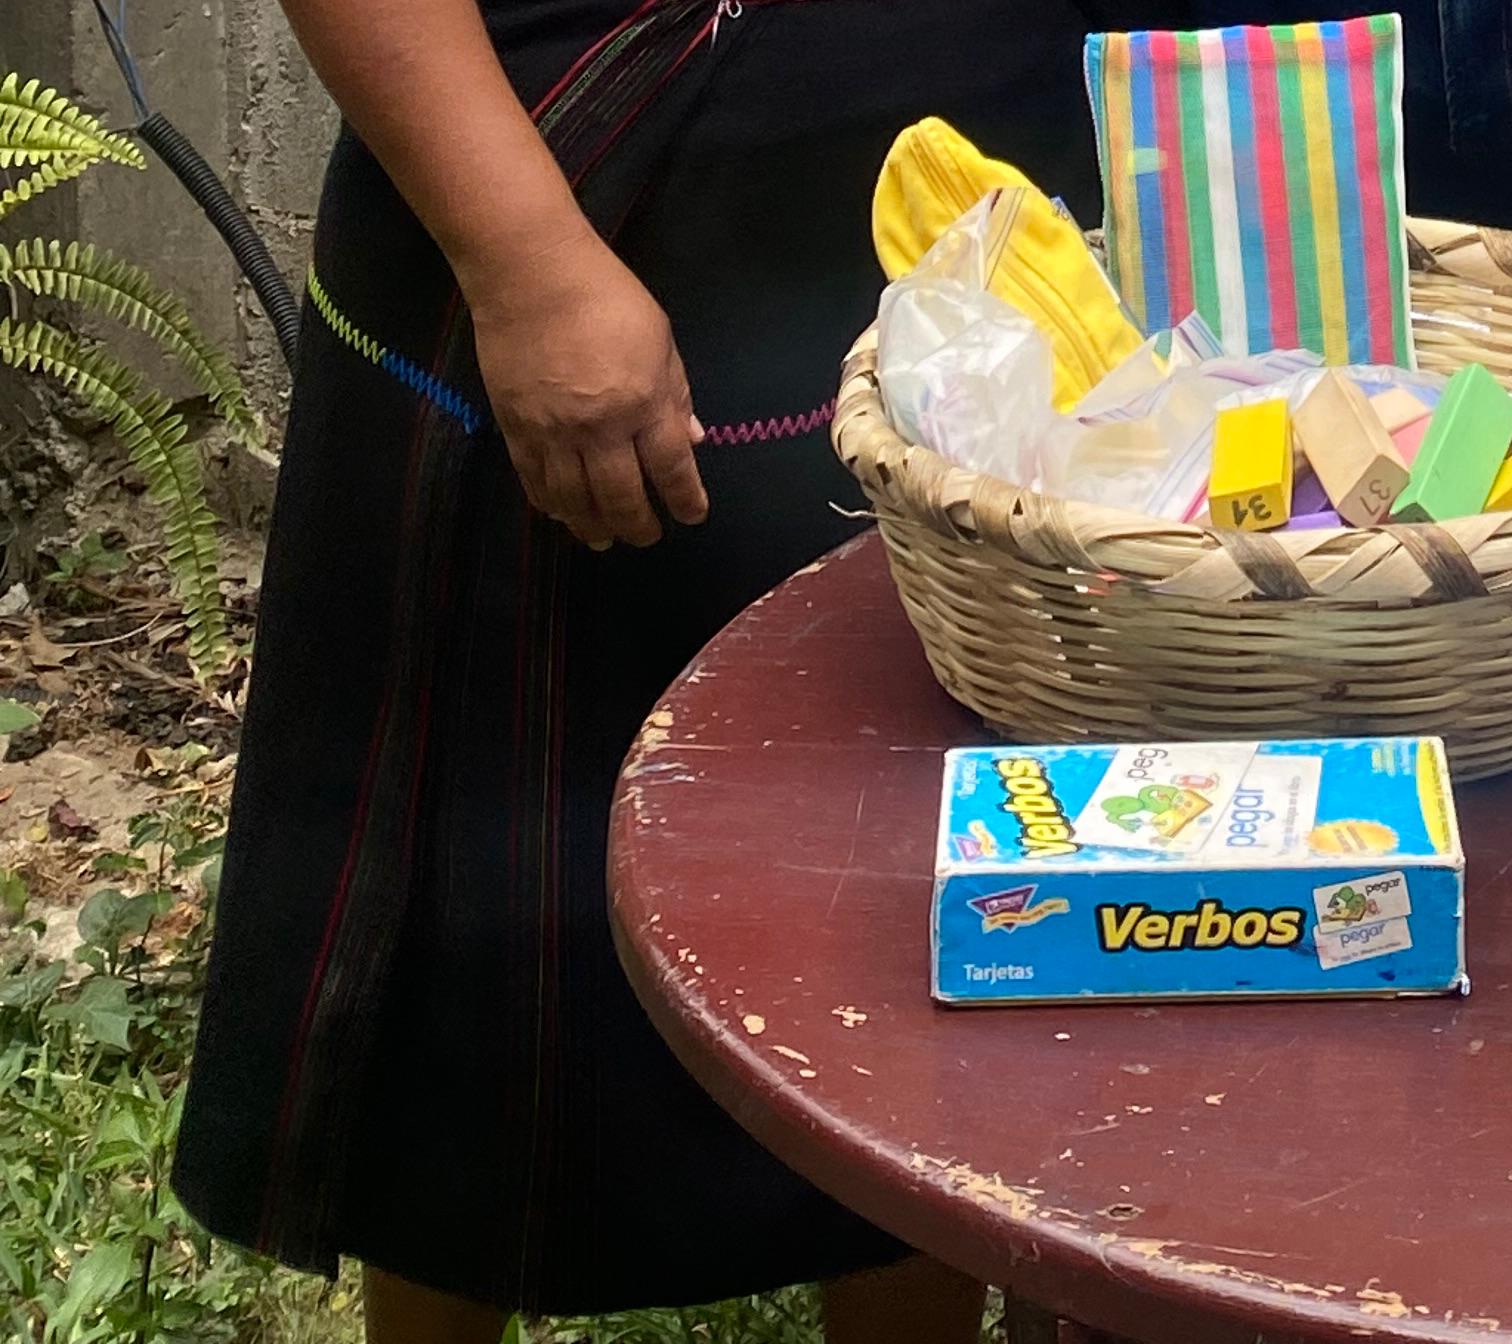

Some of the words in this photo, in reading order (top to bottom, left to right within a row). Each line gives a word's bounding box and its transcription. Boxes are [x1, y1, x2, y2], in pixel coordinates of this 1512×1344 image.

[1231, 493, 1272, 528] 31
[1359, 478, 1391, 517] 37
[995, 756, 1081, 860] Verbos
[1225, 785, 1276, 850] pegar
[1363, 877, 1402, 897] pegar
[1099, 903, 1303, 952] Verbos
[1339, 921, 1386, 949] pegar
[962, 961, 1035, 986] Tarjetas
